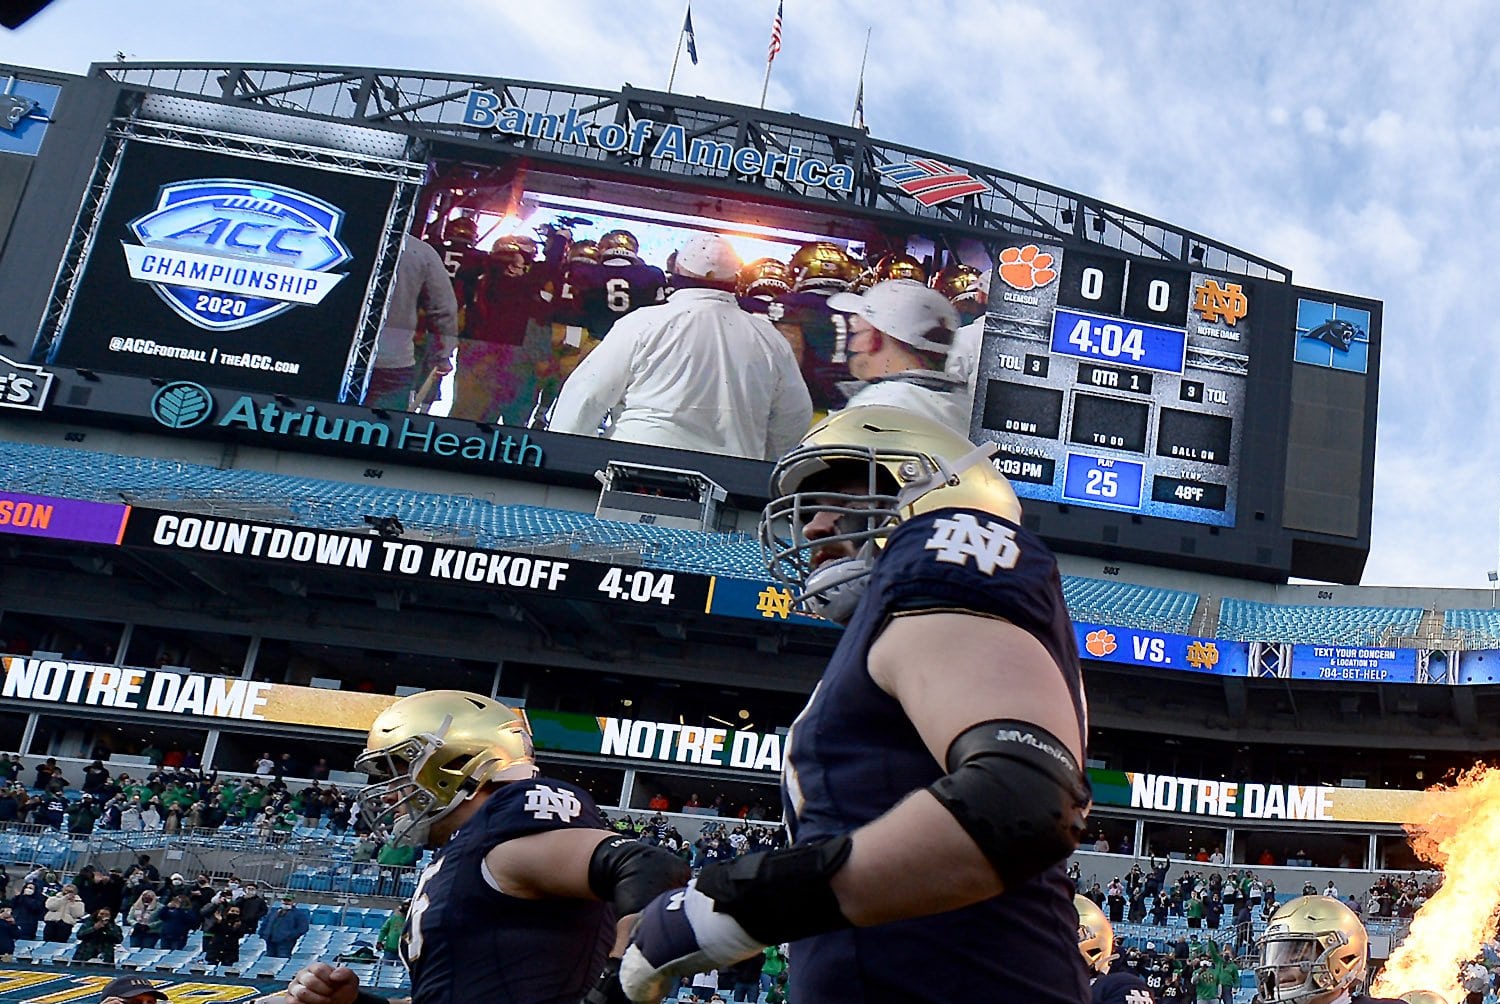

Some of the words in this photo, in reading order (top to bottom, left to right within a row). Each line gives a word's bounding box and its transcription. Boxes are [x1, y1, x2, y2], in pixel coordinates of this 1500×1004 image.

[462, 89, 590, 146] Bank
[596, 118, 653, 156] of
[650, 123, 855, 193] America
[164, 216, 318, 257] ACC
[140, 254, 319, 296] CHAMPIONSHIP
[1081, 267, 1104, 300] 0
[195, 295, 247, 317] 2020
[605, 277, 630, 312] 6
[1003, 291, 1039, 306] CLEMSON
[1147, 279, 1170, 312] 0
[1068, 319, 1146, 361] 4:04
[1197, 326, 1221, 339] NOTRE
[1220, 329, 1241, 342] DAME
[998, 353, 1022, 371] TOL
[1031, 359, 1040, 372] 3
[1091, 369, 1119, 387] QTR
[1130, 374, 1140, 391] 1
[218, 396, 389, 448] Atrium
[397, 418, 545, 468] Health
[1005, 419, 1037, 433] DOWN
[1093, 433, 1106, 445] TO
[1110, 435, 1124, 447] GO
[1097, 458, 1114, 468] PLAY
[1171, 445, 1197, 459] BALL
[1200, 450, 1215, 461] ON
[1021, 462, 1043, 478] PM
[1180, 470, 1202, 481] TEMP
[1085, 470, 1118, 498] 25
[152, 514, 369, 570] COUNTDOWN
[381, 541, 422, 575] TO
[430, 546, 570, 591] KICKOFF
[598, 567, 676, 605] 4:04
[1132, 635, 1172, 664] VS.
[1313, 647, 1334, 657] TEXT
[1335, 648, 1357, 658] YOUR
[1358, 649, 1396, 660] CONCERN
[1319, 667, 1387, 680] 704-GET-HELP
[1337, 659, 1368, 667] LOCATION
[1368, 660, 1378, 668] TO
[2, 657, 147, 709] NOTRE
[145, 671, 273, 721] DAME
[600, 717, 728, 767] NOTRE
[729, 730, 789, 773] DA
[1130, 772, 1239, 818] NOTRE
[1242, 783, 1337, 821] DAME
